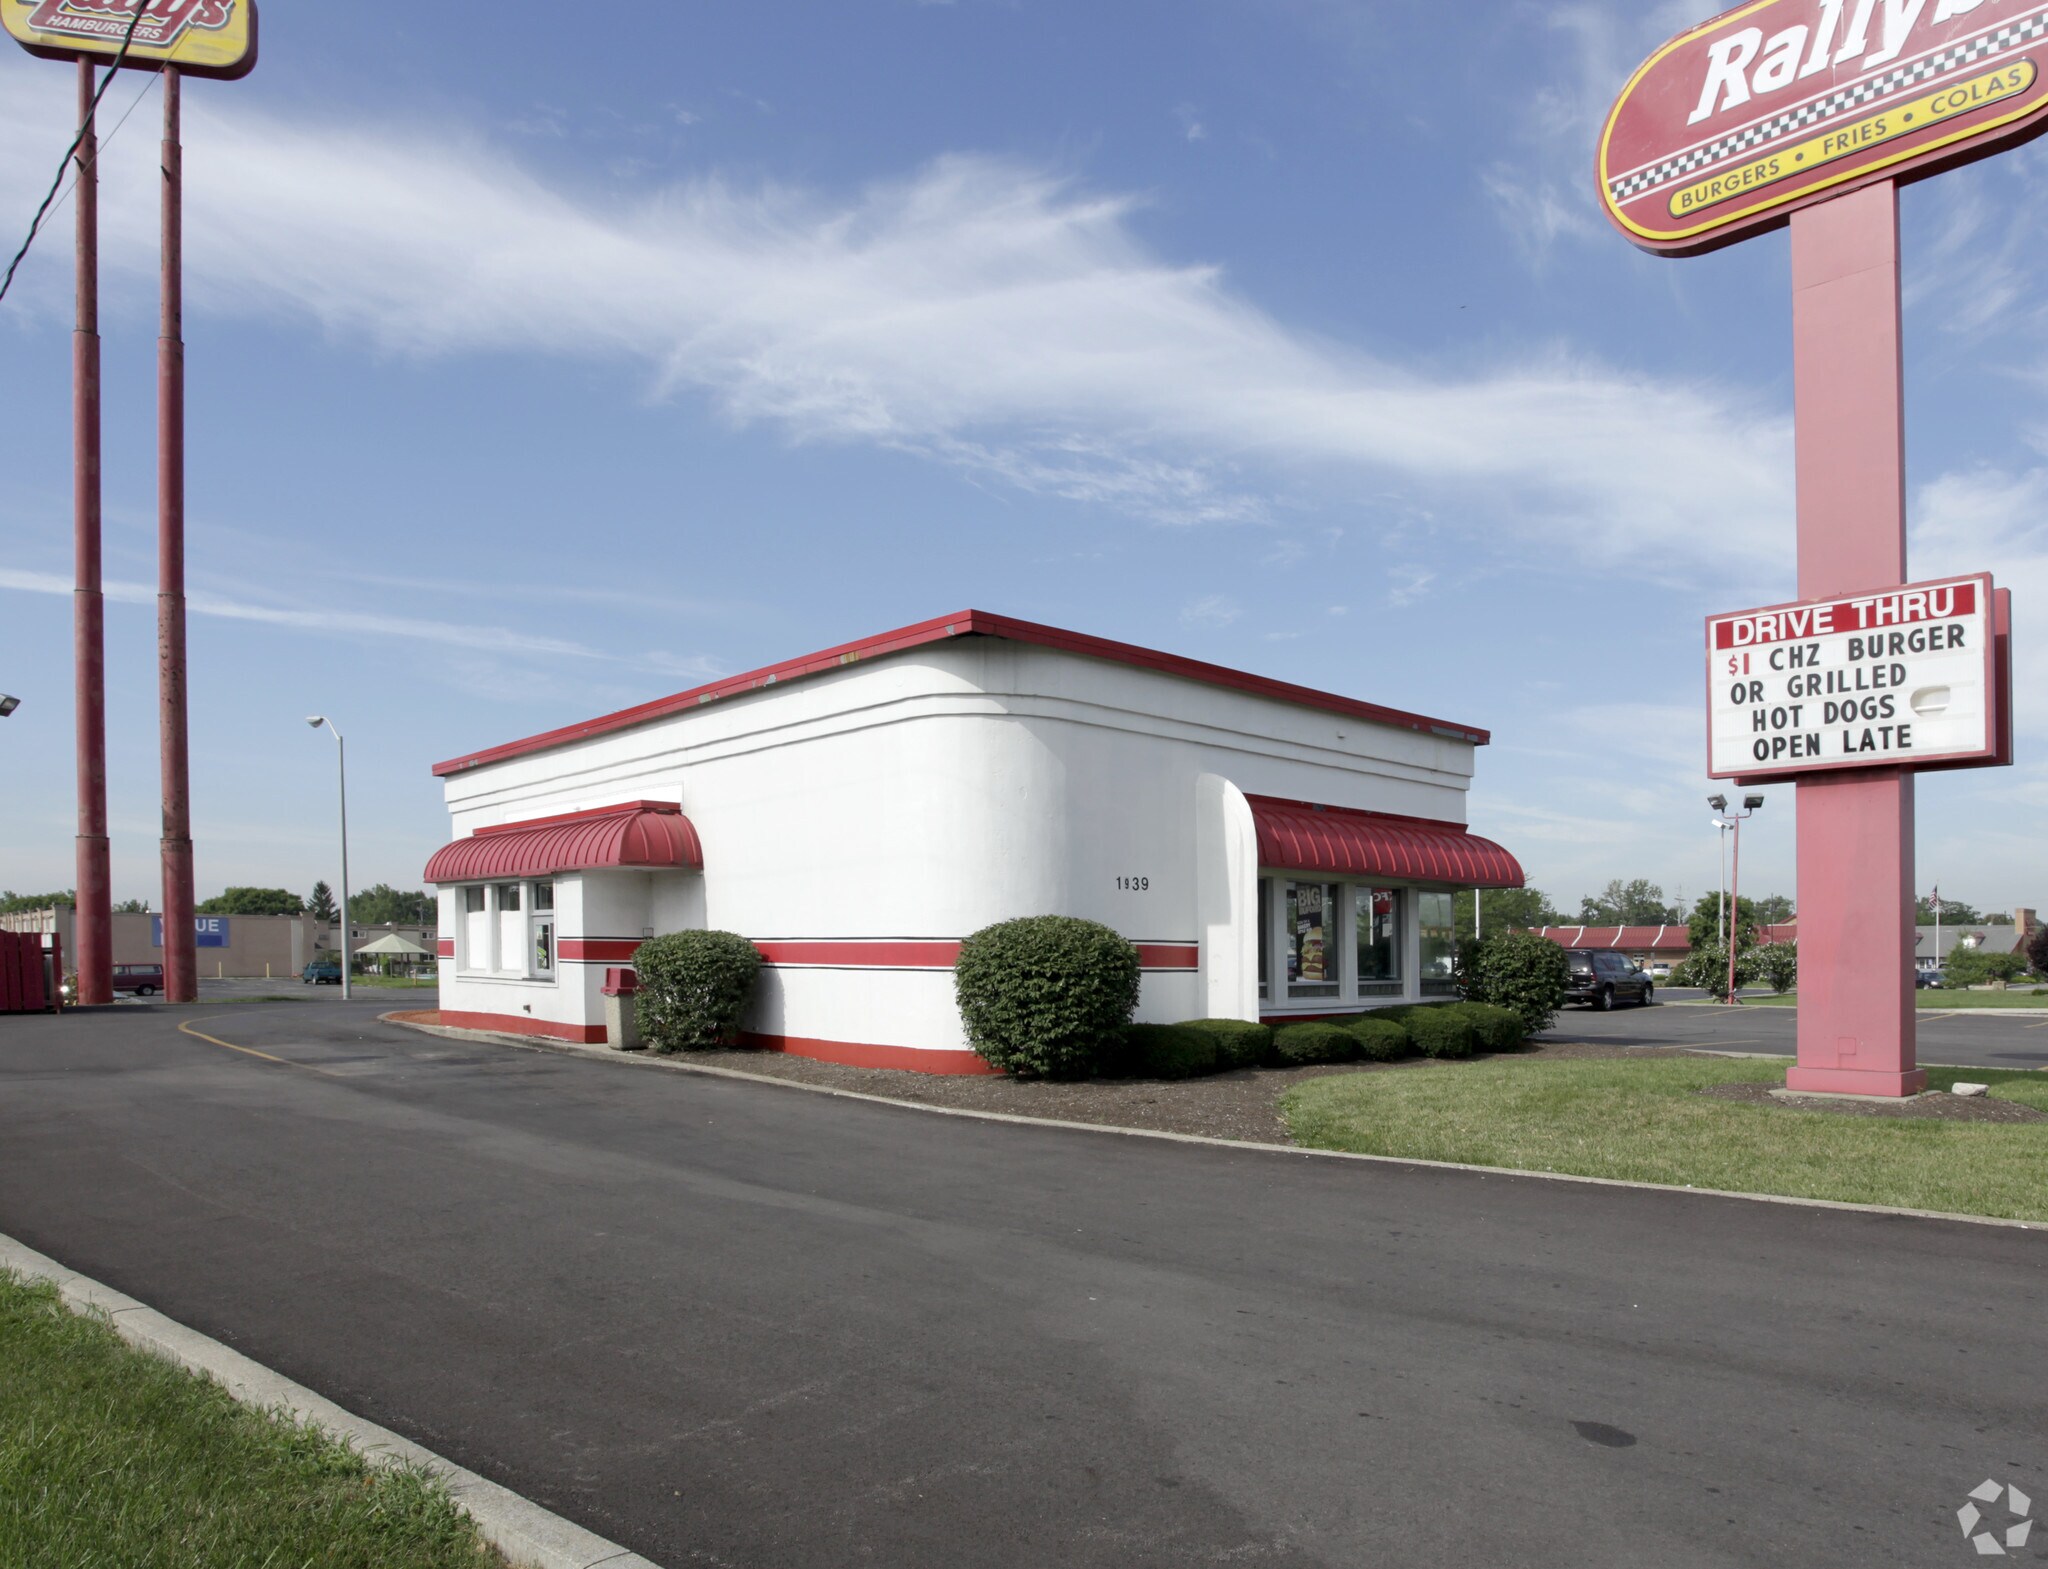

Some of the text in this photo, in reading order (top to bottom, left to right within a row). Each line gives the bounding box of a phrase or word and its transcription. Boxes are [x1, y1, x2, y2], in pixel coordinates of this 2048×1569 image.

[45, 15, 163, 40] HAMBURGERS
[1687, 0, 1986, 126] Rally
[1681, 67, 2023, 209] BURGERS FRIES COLAS
[1732, 587, 1954, 646] DRIVE THRU
[1769, 643, 1820, 671] CHZ
[1848, 623, 1965, 661] BURGER
[1730, 663, 1906, 705] OR GRILLED
[1752, 694, 1895, 732] HOT DOGS
[1753, 724, 1912, 761] OPEN LATE
[1297, 887, 1320, 906] BIG
